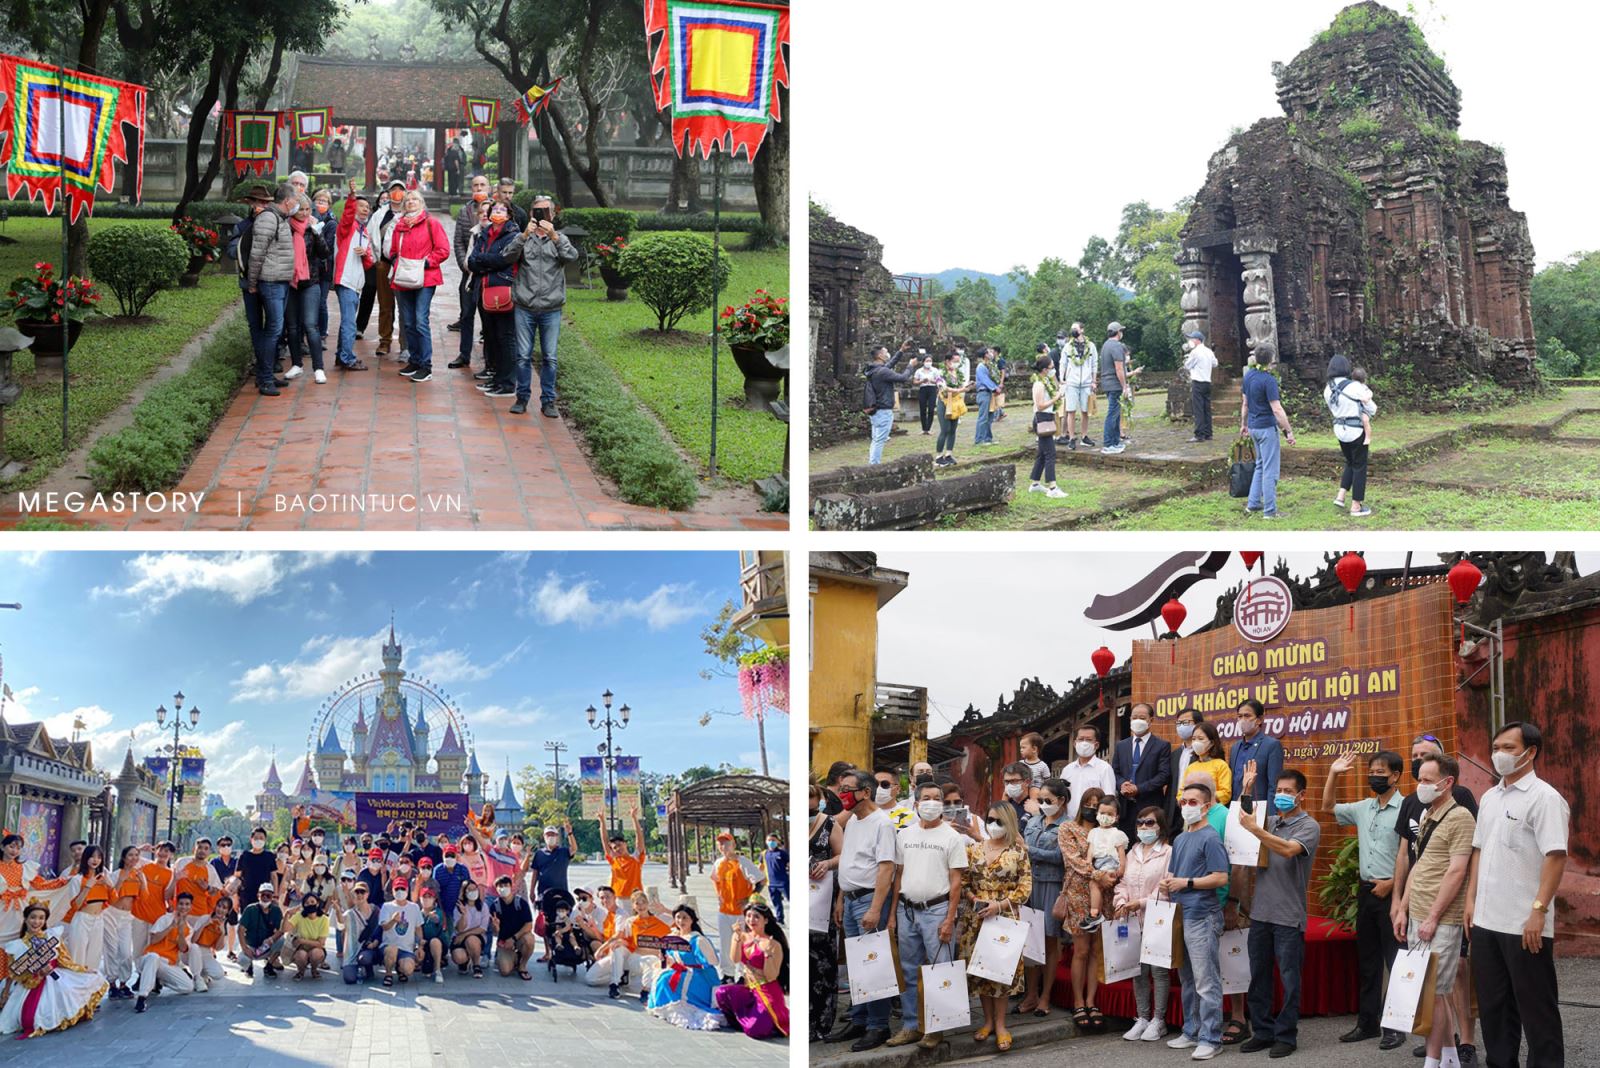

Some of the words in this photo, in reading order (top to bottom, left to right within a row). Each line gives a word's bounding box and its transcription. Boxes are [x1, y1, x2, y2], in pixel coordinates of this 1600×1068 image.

[1213, 650, 1258, 676] CHÀO
[1265, 641, 1326, 669] MỪNG
[1156, 693, 1188, 718] QUÝ
[1193, 688, 1249, 712] KHÁCH
[1255, 677, 1279, 704] VỀ
[1285, 676, 1318, 702] VỚI
[1325, 671, 1360, 700] HỘI
[1368, 669, 1396, 694] AN
[1264, 718, 1284, 734] TO
[1289, 713, 1317, 736] HỘI
[1322, 711, 1348, 730] AN
[1294, 744, 1320, 759] ngày
[1322, 741, 1380, 756] 20/11/2021
